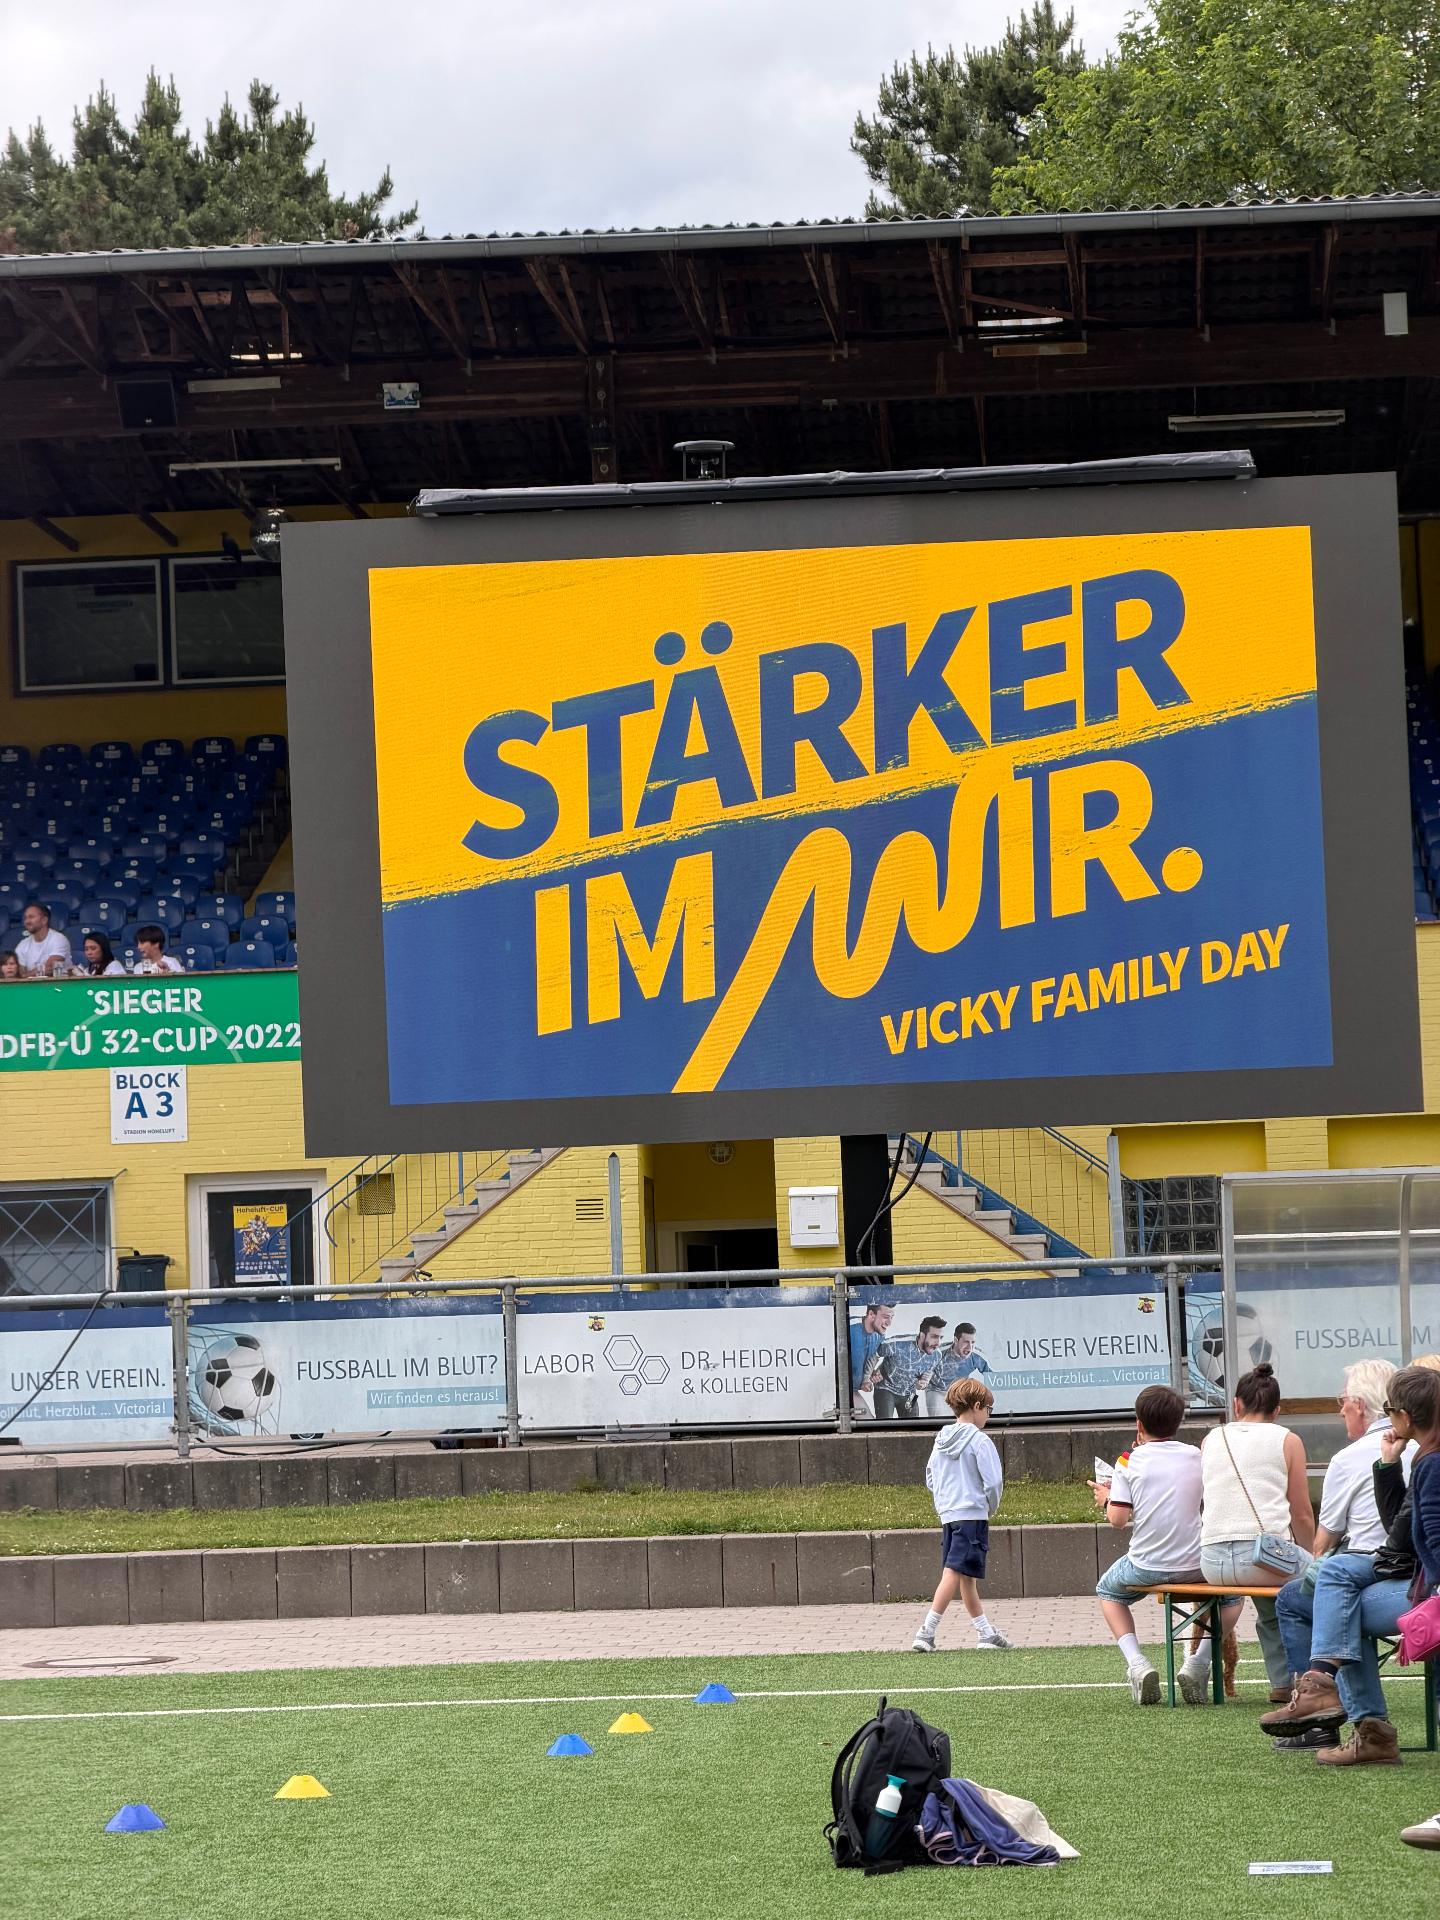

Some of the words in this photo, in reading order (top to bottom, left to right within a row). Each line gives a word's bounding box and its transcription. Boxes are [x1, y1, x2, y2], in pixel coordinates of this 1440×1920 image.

[462, 569, 1192, 862] STÄRKER
[534, 851, 717, 1037] IM
[672, 759, 1204, 1094] WIR.
[94, 988, 203, 1016] SIEGER
[880, 985, 1020, 1056] VICKY
[1031, 946, 1190, 1023] FAMILY
[1200, 923, 1290, 984] DAY
[0, 1025, 92, 1059] DFB-Ü
[102, 1026, 218, 1055] 32-CUP
[227, 1022, 301, 1051] 2022
[116, 1073, 181, 1090] BLOCK
[125, 1091, 148, 1119] A
[156, 1090, 173, 1117] 3
[1007, 1337, 1077, 1360] UNSER
[1083, 1334, 1164, 1357] VEREIN.
[1295, 1326, 1398, 1350] FUSSBALL
[297, 1358, 397, 1381] FUSSBALL
[403, 1357, 429, 1378] IM
[437, 1354, 498, 1377] BLUT?
[523, 1353, 595, 1375] LABOR
[722, 1347, 827, 1370] HEIDRICH
[11, 1370, 80, 1392] UNSER
[86, 1367, 166, 1389] VEREIN.
[682, 1378, 696, 1394] &
[700, 1376, 788, 1394] KOLLEGEN
[988, 1373, 1039, 1388] Vollblut,
[1043, 1371, 1095, 1386] Herzblut
[1113, 1367, 1166, 1383] Victoria!
[45, 1403, 97, 1417] Herzblut
[114, 1401, 167, 1415] Victoria!
[370, 1392, 392, 1405] Wir
[395, 1391, 433, 1405] finden
[437, 1393, 451, 1403] es
[454, 1388, 499, 1402] heraus!
